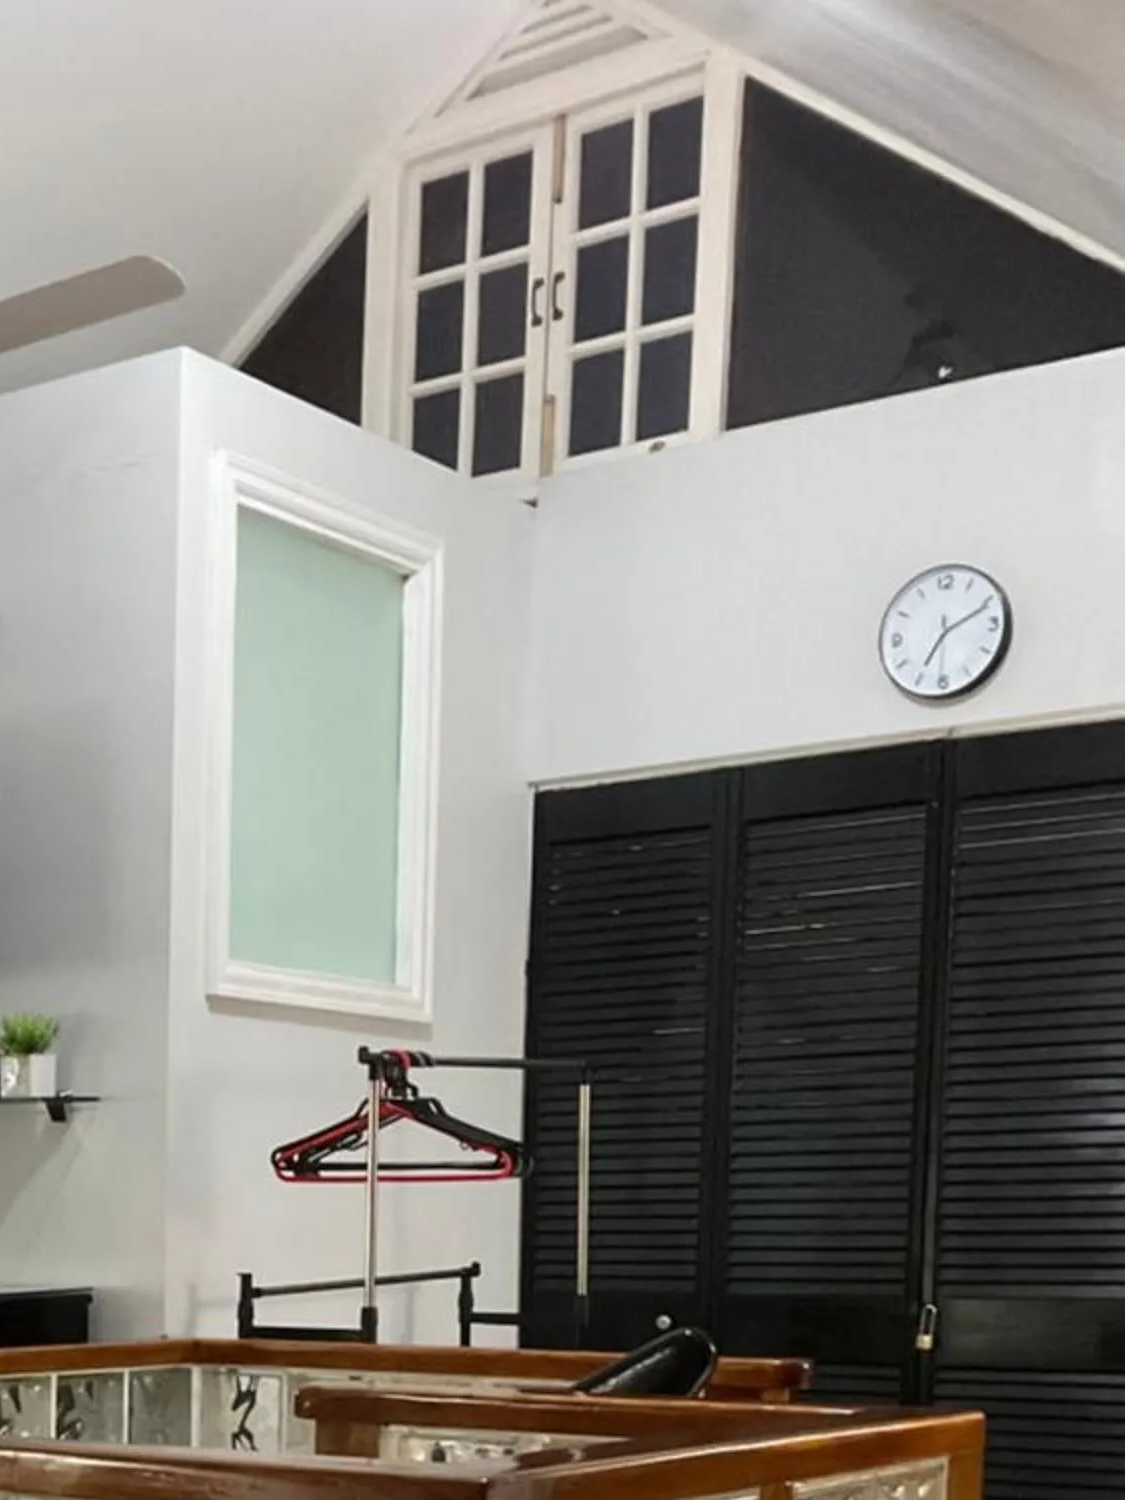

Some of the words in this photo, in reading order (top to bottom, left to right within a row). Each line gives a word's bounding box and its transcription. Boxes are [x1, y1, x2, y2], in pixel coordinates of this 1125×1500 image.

[937, 574, 954, 590] 12
[987, 616, 1000, 632] 3
[937, 674, 950, 690] 6
